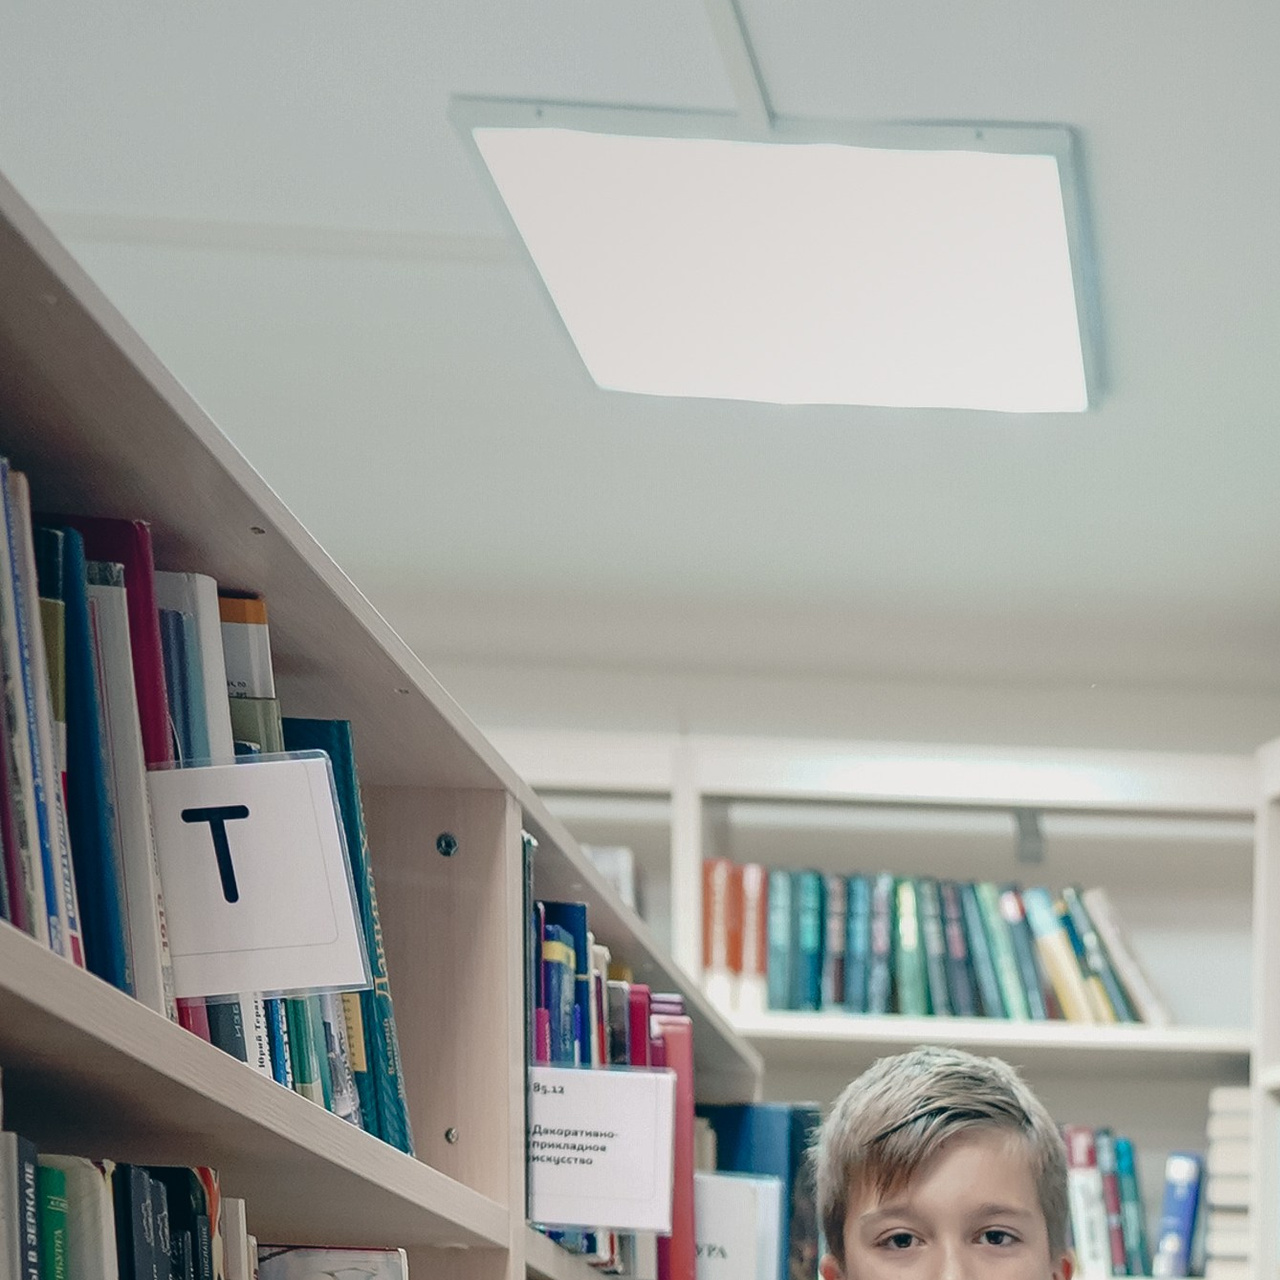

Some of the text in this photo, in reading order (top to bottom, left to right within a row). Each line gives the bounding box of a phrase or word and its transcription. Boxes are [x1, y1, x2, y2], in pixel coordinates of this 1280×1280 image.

[180, 804, 250, 904] Т
[531, 1139, 607, 1153] прикладное
[23, 1160, 37, 1245] ЗЕРКАЛЕ
[27, 1249, 38, 1261] В
